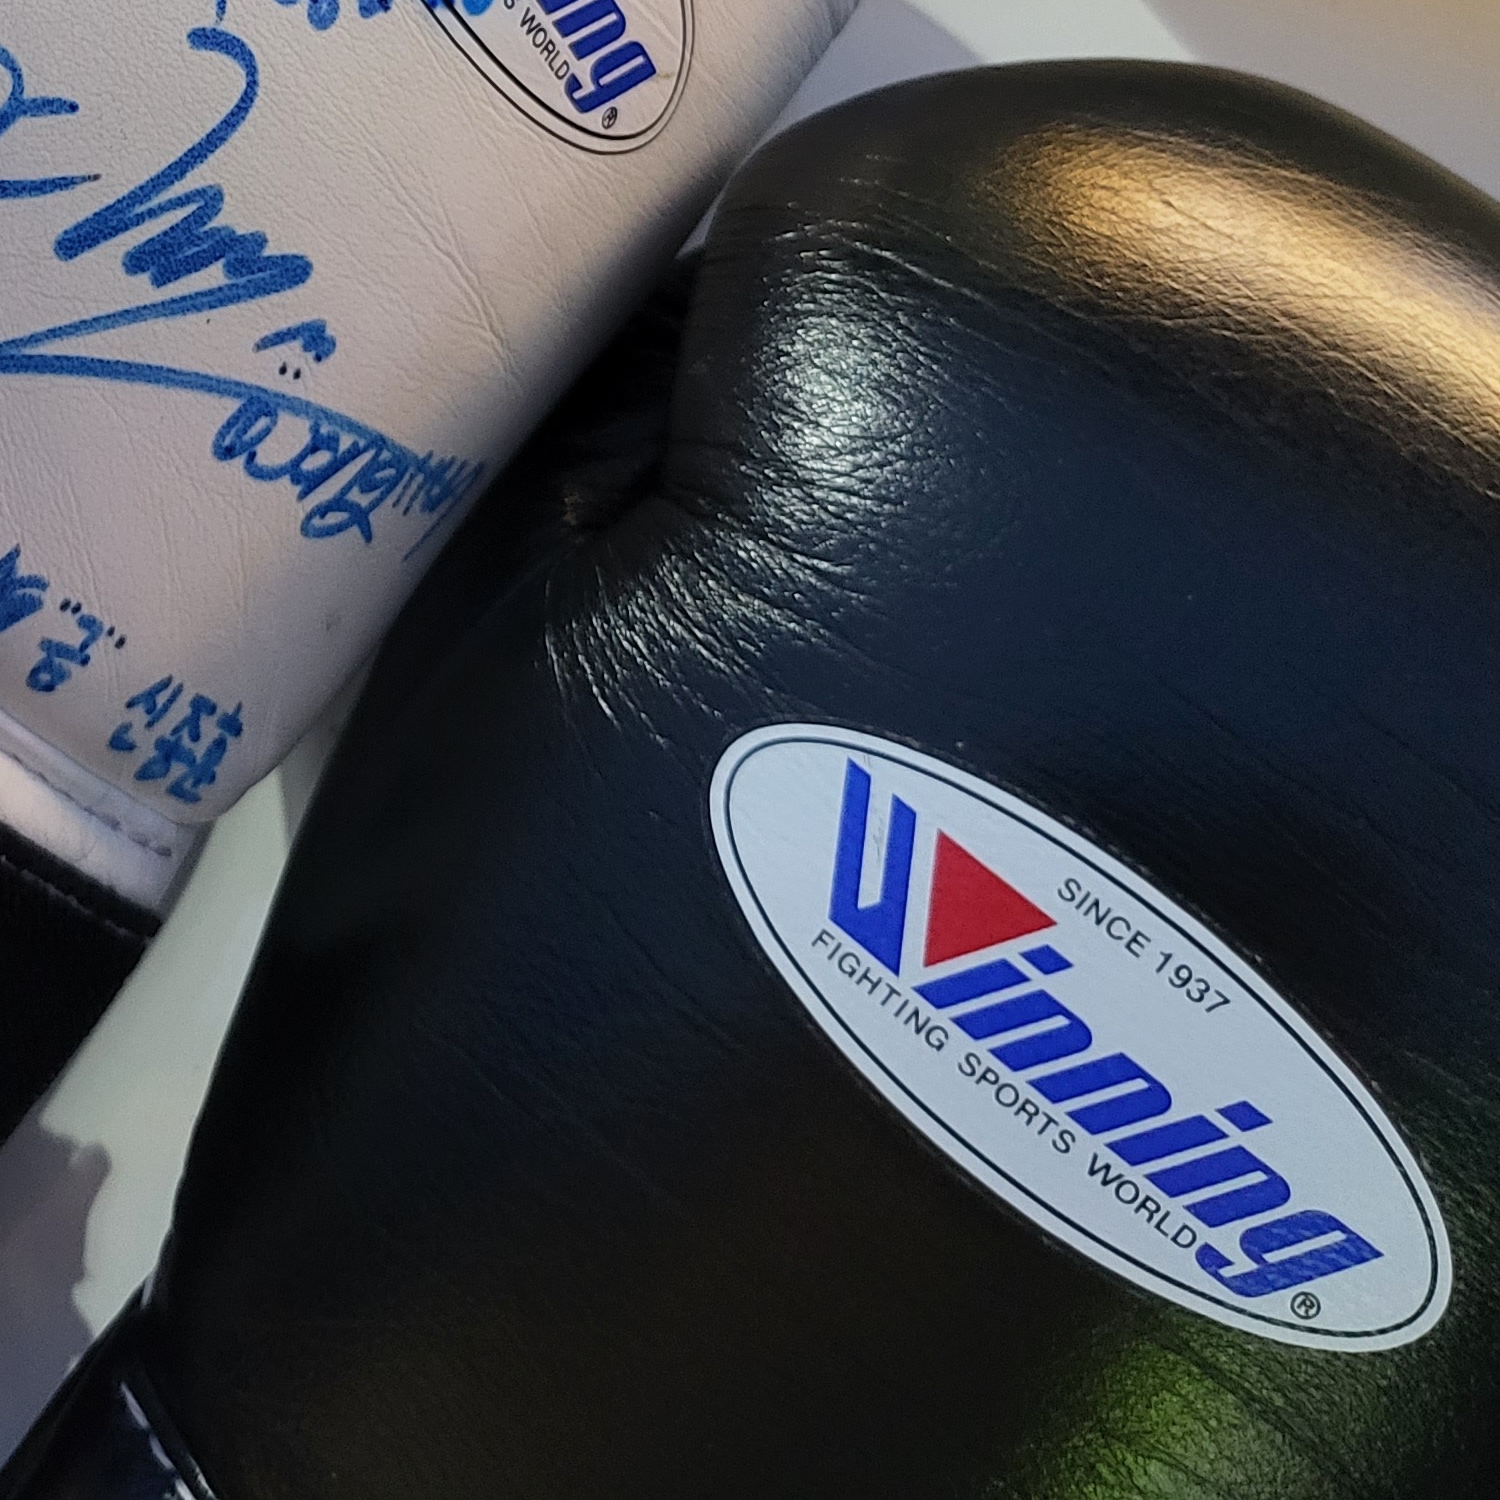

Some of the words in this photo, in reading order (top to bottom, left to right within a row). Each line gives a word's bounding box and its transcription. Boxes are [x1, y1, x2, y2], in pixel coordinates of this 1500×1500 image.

[520, 7, 569, 81] WORLD
[828, 757, 1385, 1298] Winning
[1056, 877, 1152, 958] SINCE
[1156, 948, 1231, 1018] 1937
[810, 928, 950, 1054] FIGHTING
[957, 1052, 1078, 1156] SPORTS
[1087, 1152, 1198, 1251] WORLD
